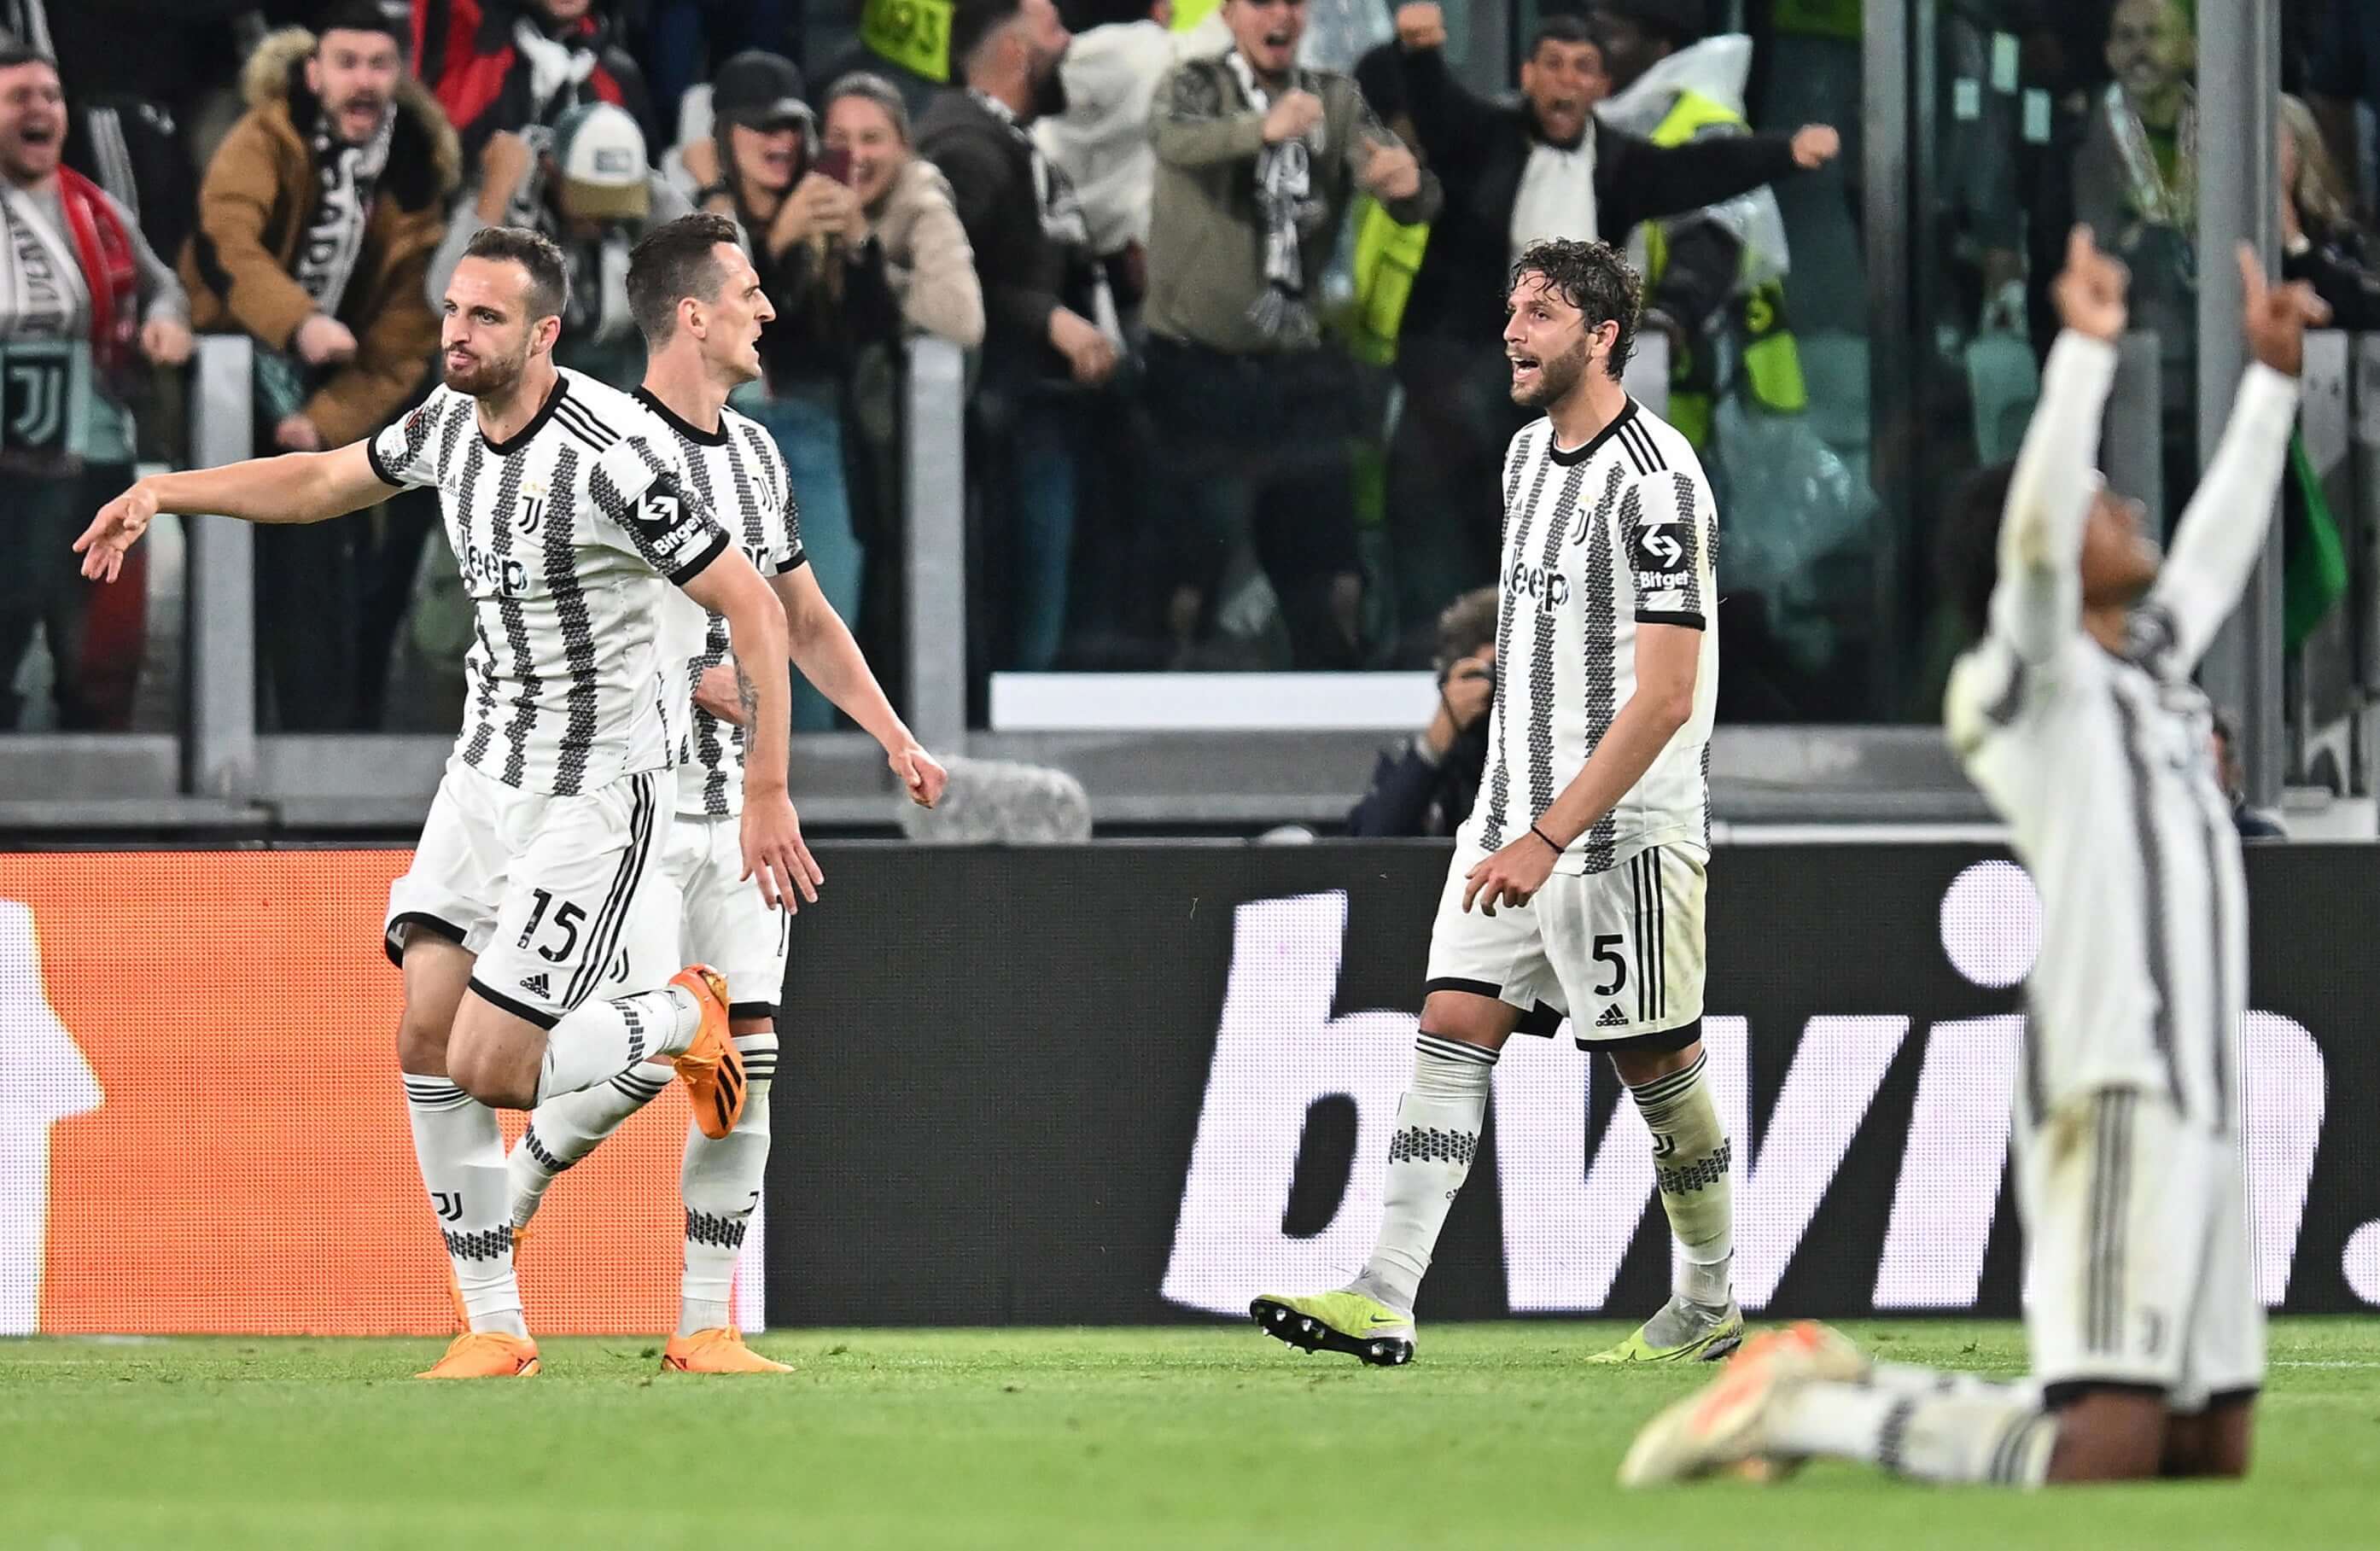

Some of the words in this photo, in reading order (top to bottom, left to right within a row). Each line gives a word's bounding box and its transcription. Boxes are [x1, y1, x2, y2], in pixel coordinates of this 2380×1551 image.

[652, 511, 703, 557] Bitget
[1503, 546, 1569, 613] Jeep
[1640, 569, 1690, 591] Bitget
[516, 887, 587, 963] 15
[1593, 934, 1627, 996] 5
